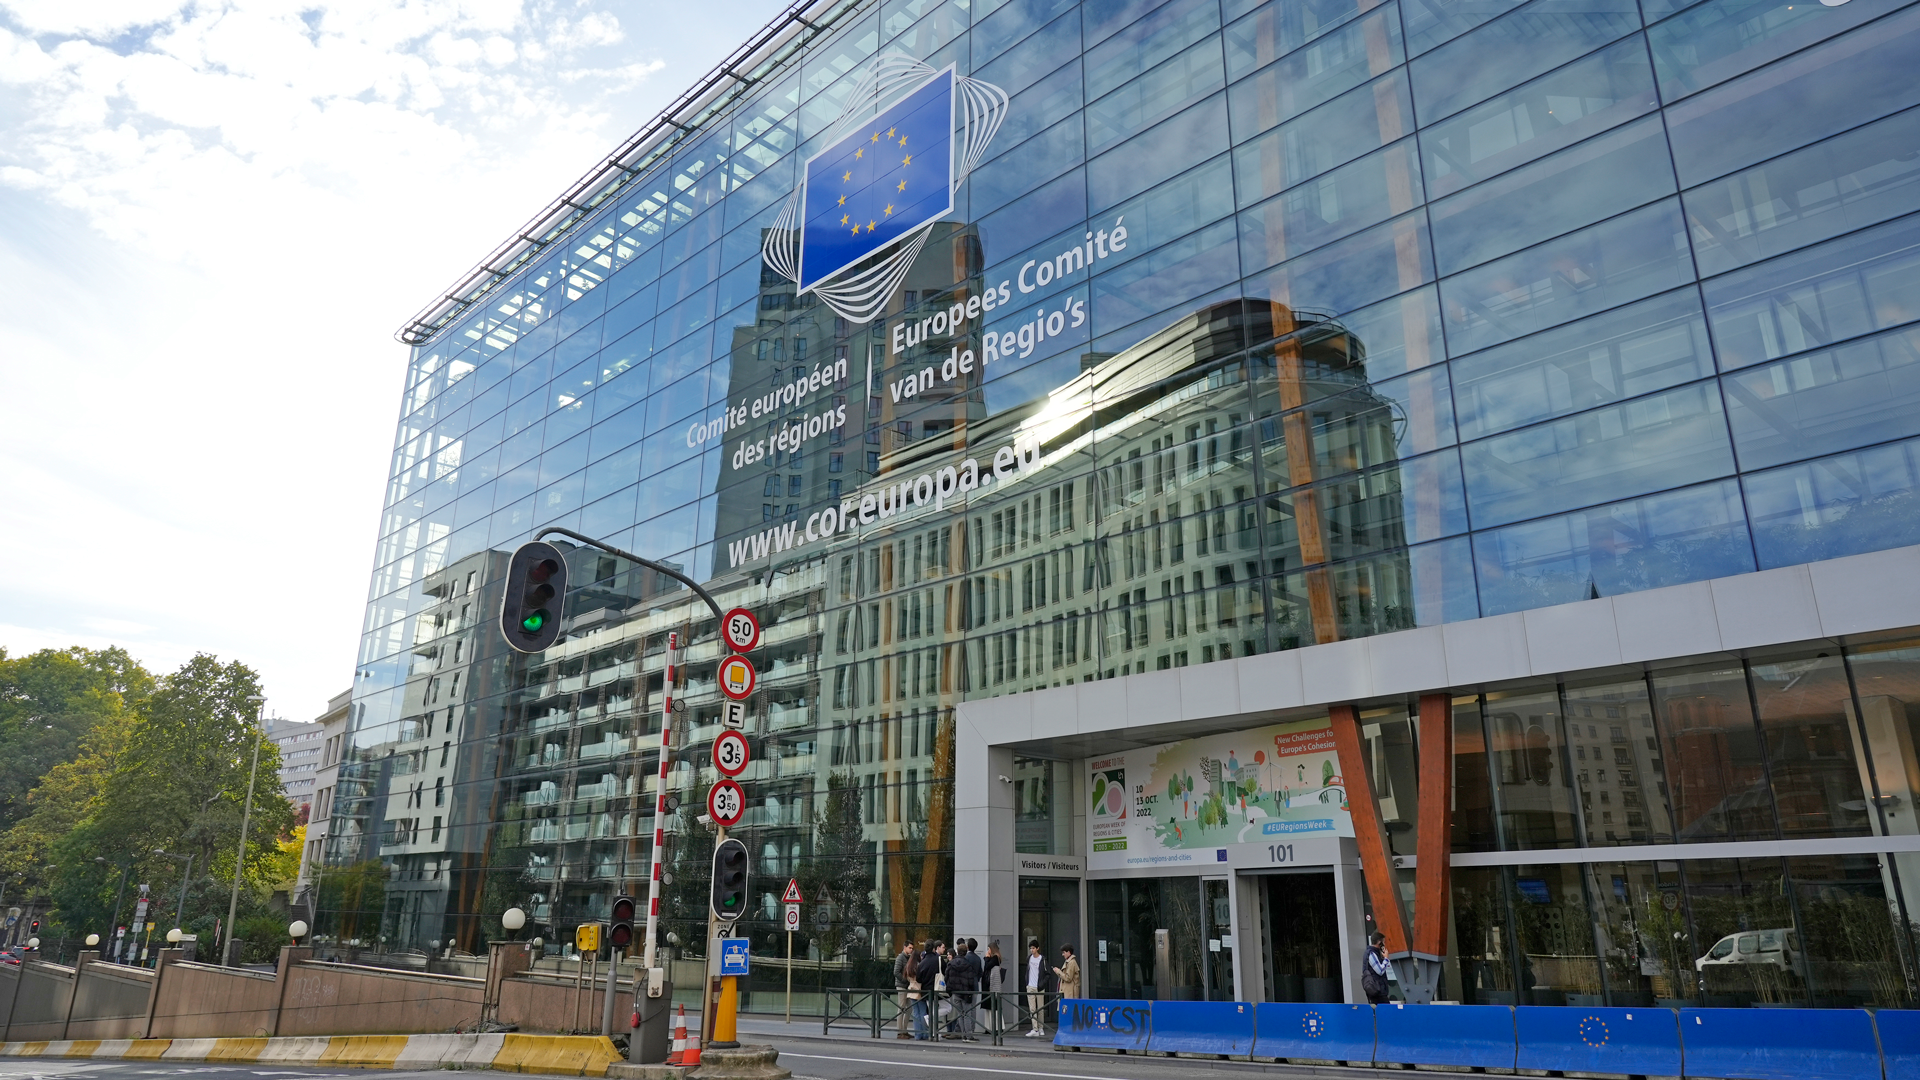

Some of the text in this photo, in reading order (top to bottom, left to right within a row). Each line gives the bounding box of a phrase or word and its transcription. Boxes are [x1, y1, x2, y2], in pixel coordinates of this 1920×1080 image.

[892, 215, 1128, 355] Europees Comité
[889, 296, 1086, 403] van de Regio's
[686, 356, 847, 449] Comité européen
[732, 404, 846, 471] des régions
[728, 430, 1041, 568] www.cor.europa.eu
[731, 619, 751, 637] 50
[735, 635, 746, 644] km
[728, 705, 741, 724] E
[1277, 730, 1334, 745] New Challenges fo
[722, 742, 734, 764] 3
[734, 753, 741, 764] 5
[1280, 744, 1307, 754] Europe's
[1092, 759, 1112, 770] WELCOME
[1136, 785, 1144, 794] 10
[718, 794, 726, 810] 3
[726, 802, 737, 812] 50
[1136, 795, 1158, 805] 13 OCT.
[1136, 808, 1152, 817] 2022
[1267, 820, 1327, 832] #EURegionsWeek
[1112, 842, 1125, 850] 2022
[1268, 844, 1294, 863] 101
[1022, 860, 1046, 870] Visitors
[1052, 862, 1080, 870] Visiteurs
[1790, 863, 1827, 871] ommittee
[1216, 904, 1230, 919] 10
[1072, 1004, 1151, 1044] NO CST
